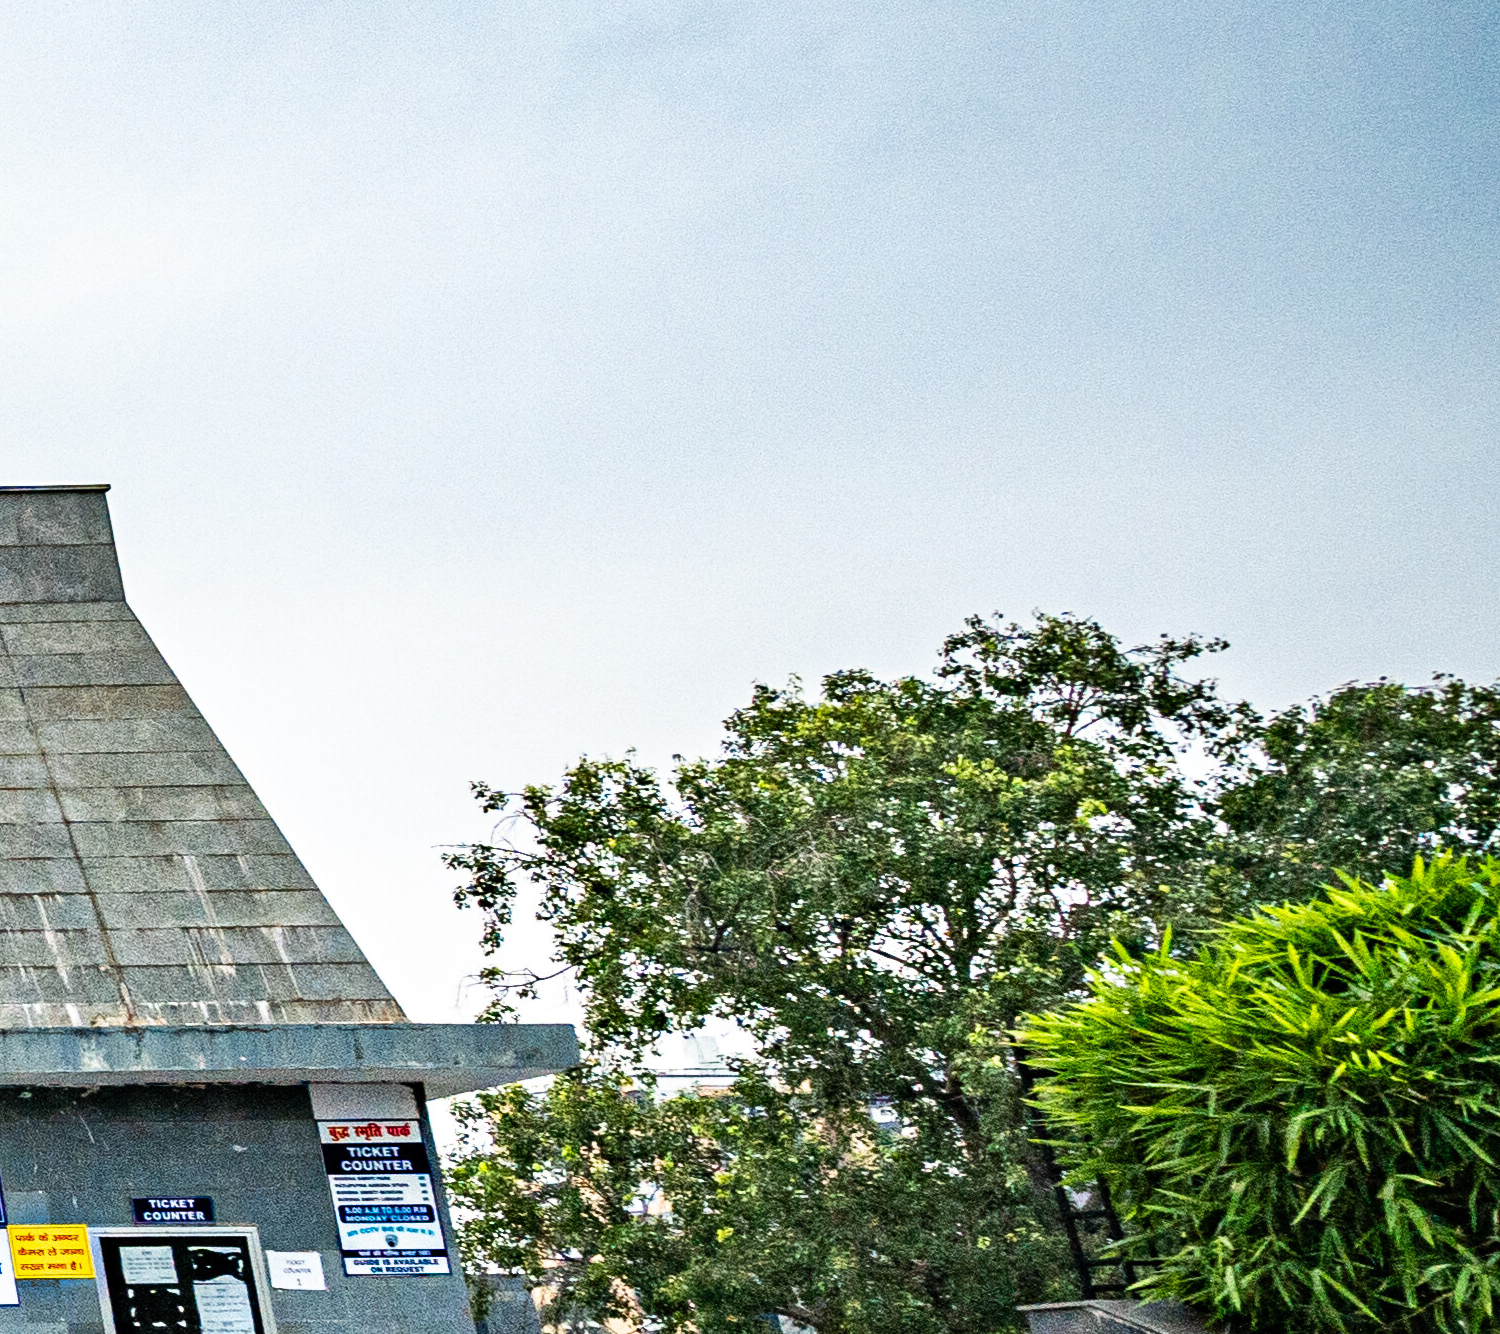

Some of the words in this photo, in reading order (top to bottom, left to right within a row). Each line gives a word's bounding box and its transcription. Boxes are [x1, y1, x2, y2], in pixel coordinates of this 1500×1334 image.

[346, 1147, 400, 1157] TICKET
[341, 1160, 413, 1171] COUNTER
[148, 1199, 195, 1208] TICKET
[143, 1211, 205, 1220] COUNTER
